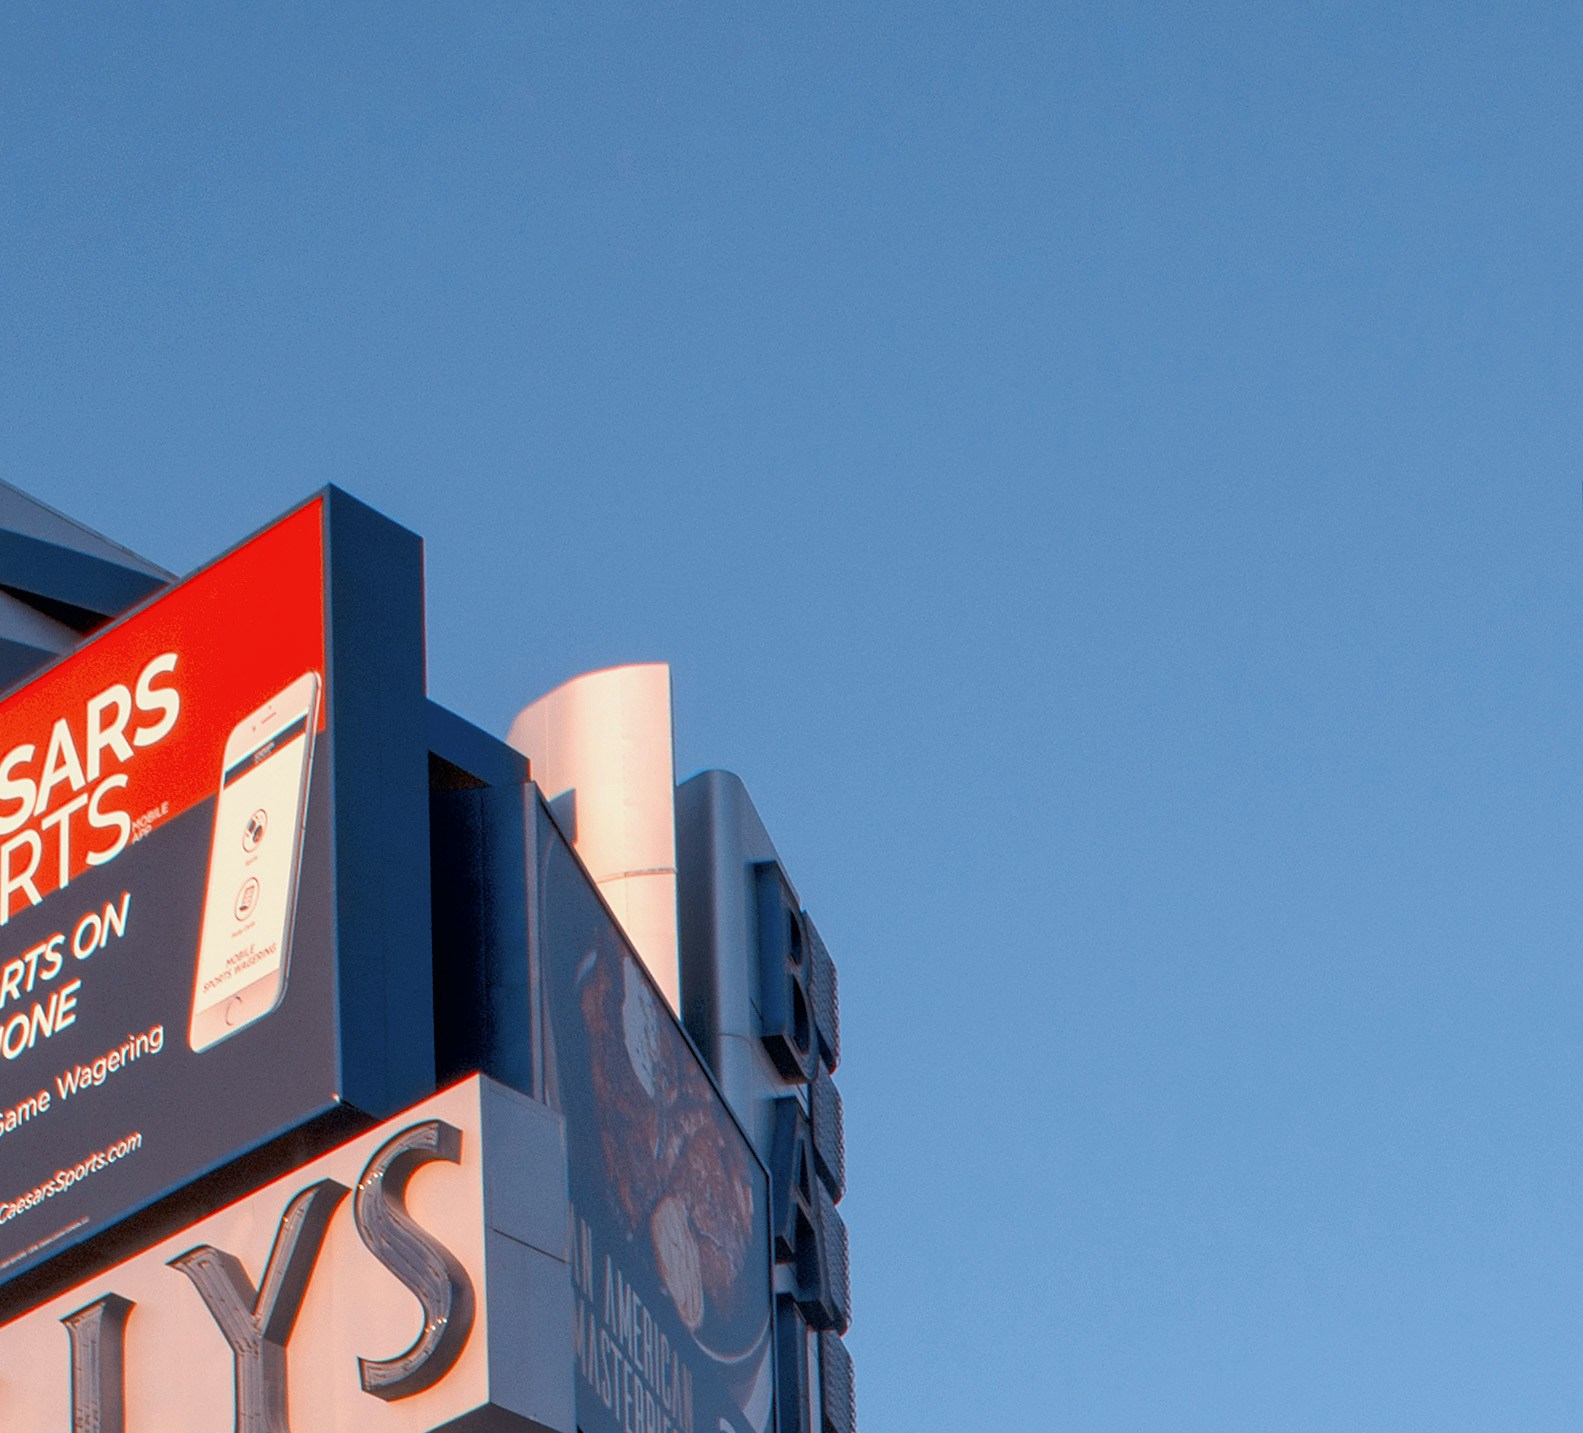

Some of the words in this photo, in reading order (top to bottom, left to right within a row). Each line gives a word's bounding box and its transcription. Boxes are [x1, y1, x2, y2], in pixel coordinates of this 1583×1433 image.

[132, 801, 169, 831] MOBILE
[72, 891, 130, 960] ON
[56, 1025, 164, 1100] Wagering
